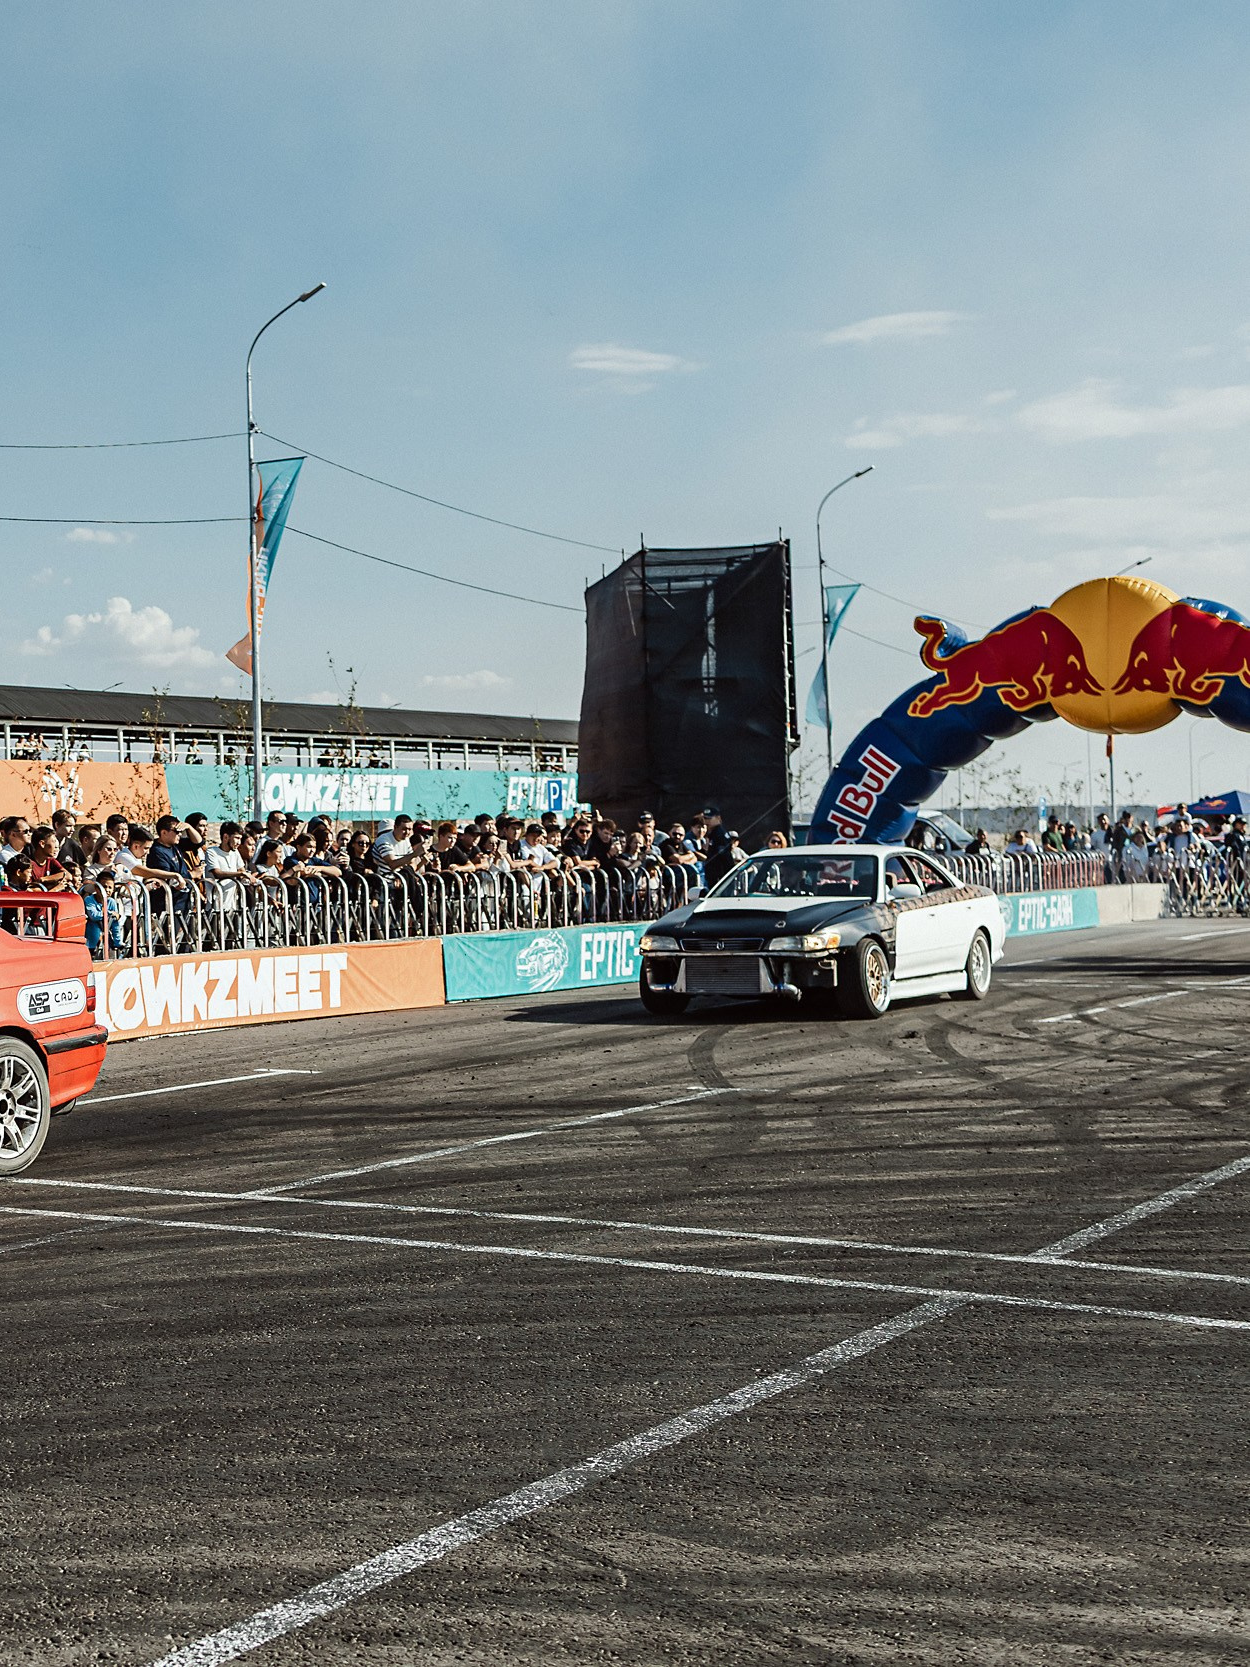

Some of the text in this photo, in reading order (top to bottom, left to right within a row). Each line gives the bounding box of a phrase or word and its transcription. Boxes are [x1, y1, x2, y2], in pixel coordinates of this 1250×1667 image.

[550, 782, 560, 809] P
[836, 745, 900, 819] Bull
[29, 992, 50, 1007] ASP
